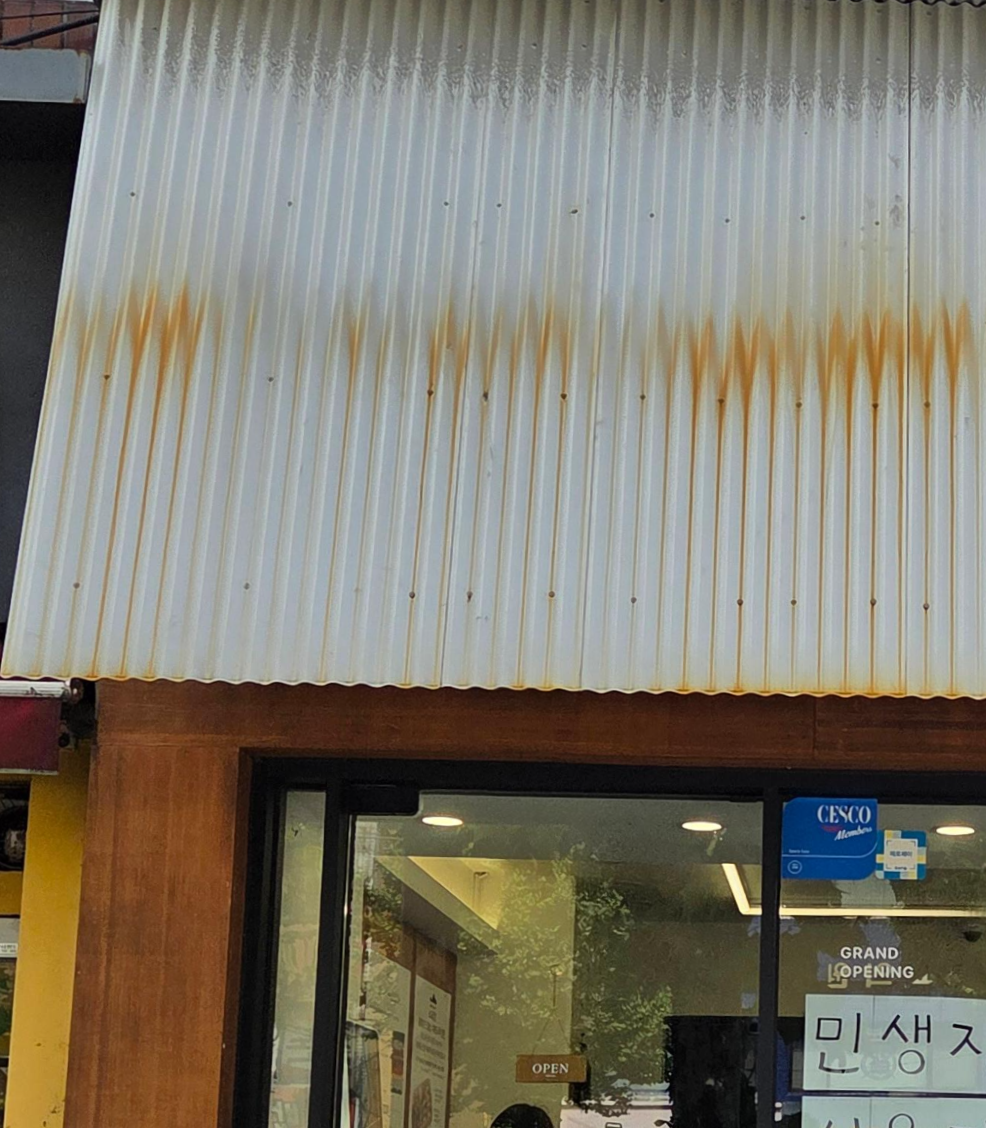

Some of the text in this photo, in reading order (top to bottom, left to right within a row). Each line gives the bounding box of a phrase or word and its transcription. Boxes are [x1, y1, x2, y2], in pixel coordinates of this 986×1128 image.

[816, 804, 871, 824] CESCO
[834, 825, 873, 841] Members
[840, 946, 899, 960] GRAND
[840, 965, 915, 980] OPENING
[532, 1062, 569, 1075] OPEN
